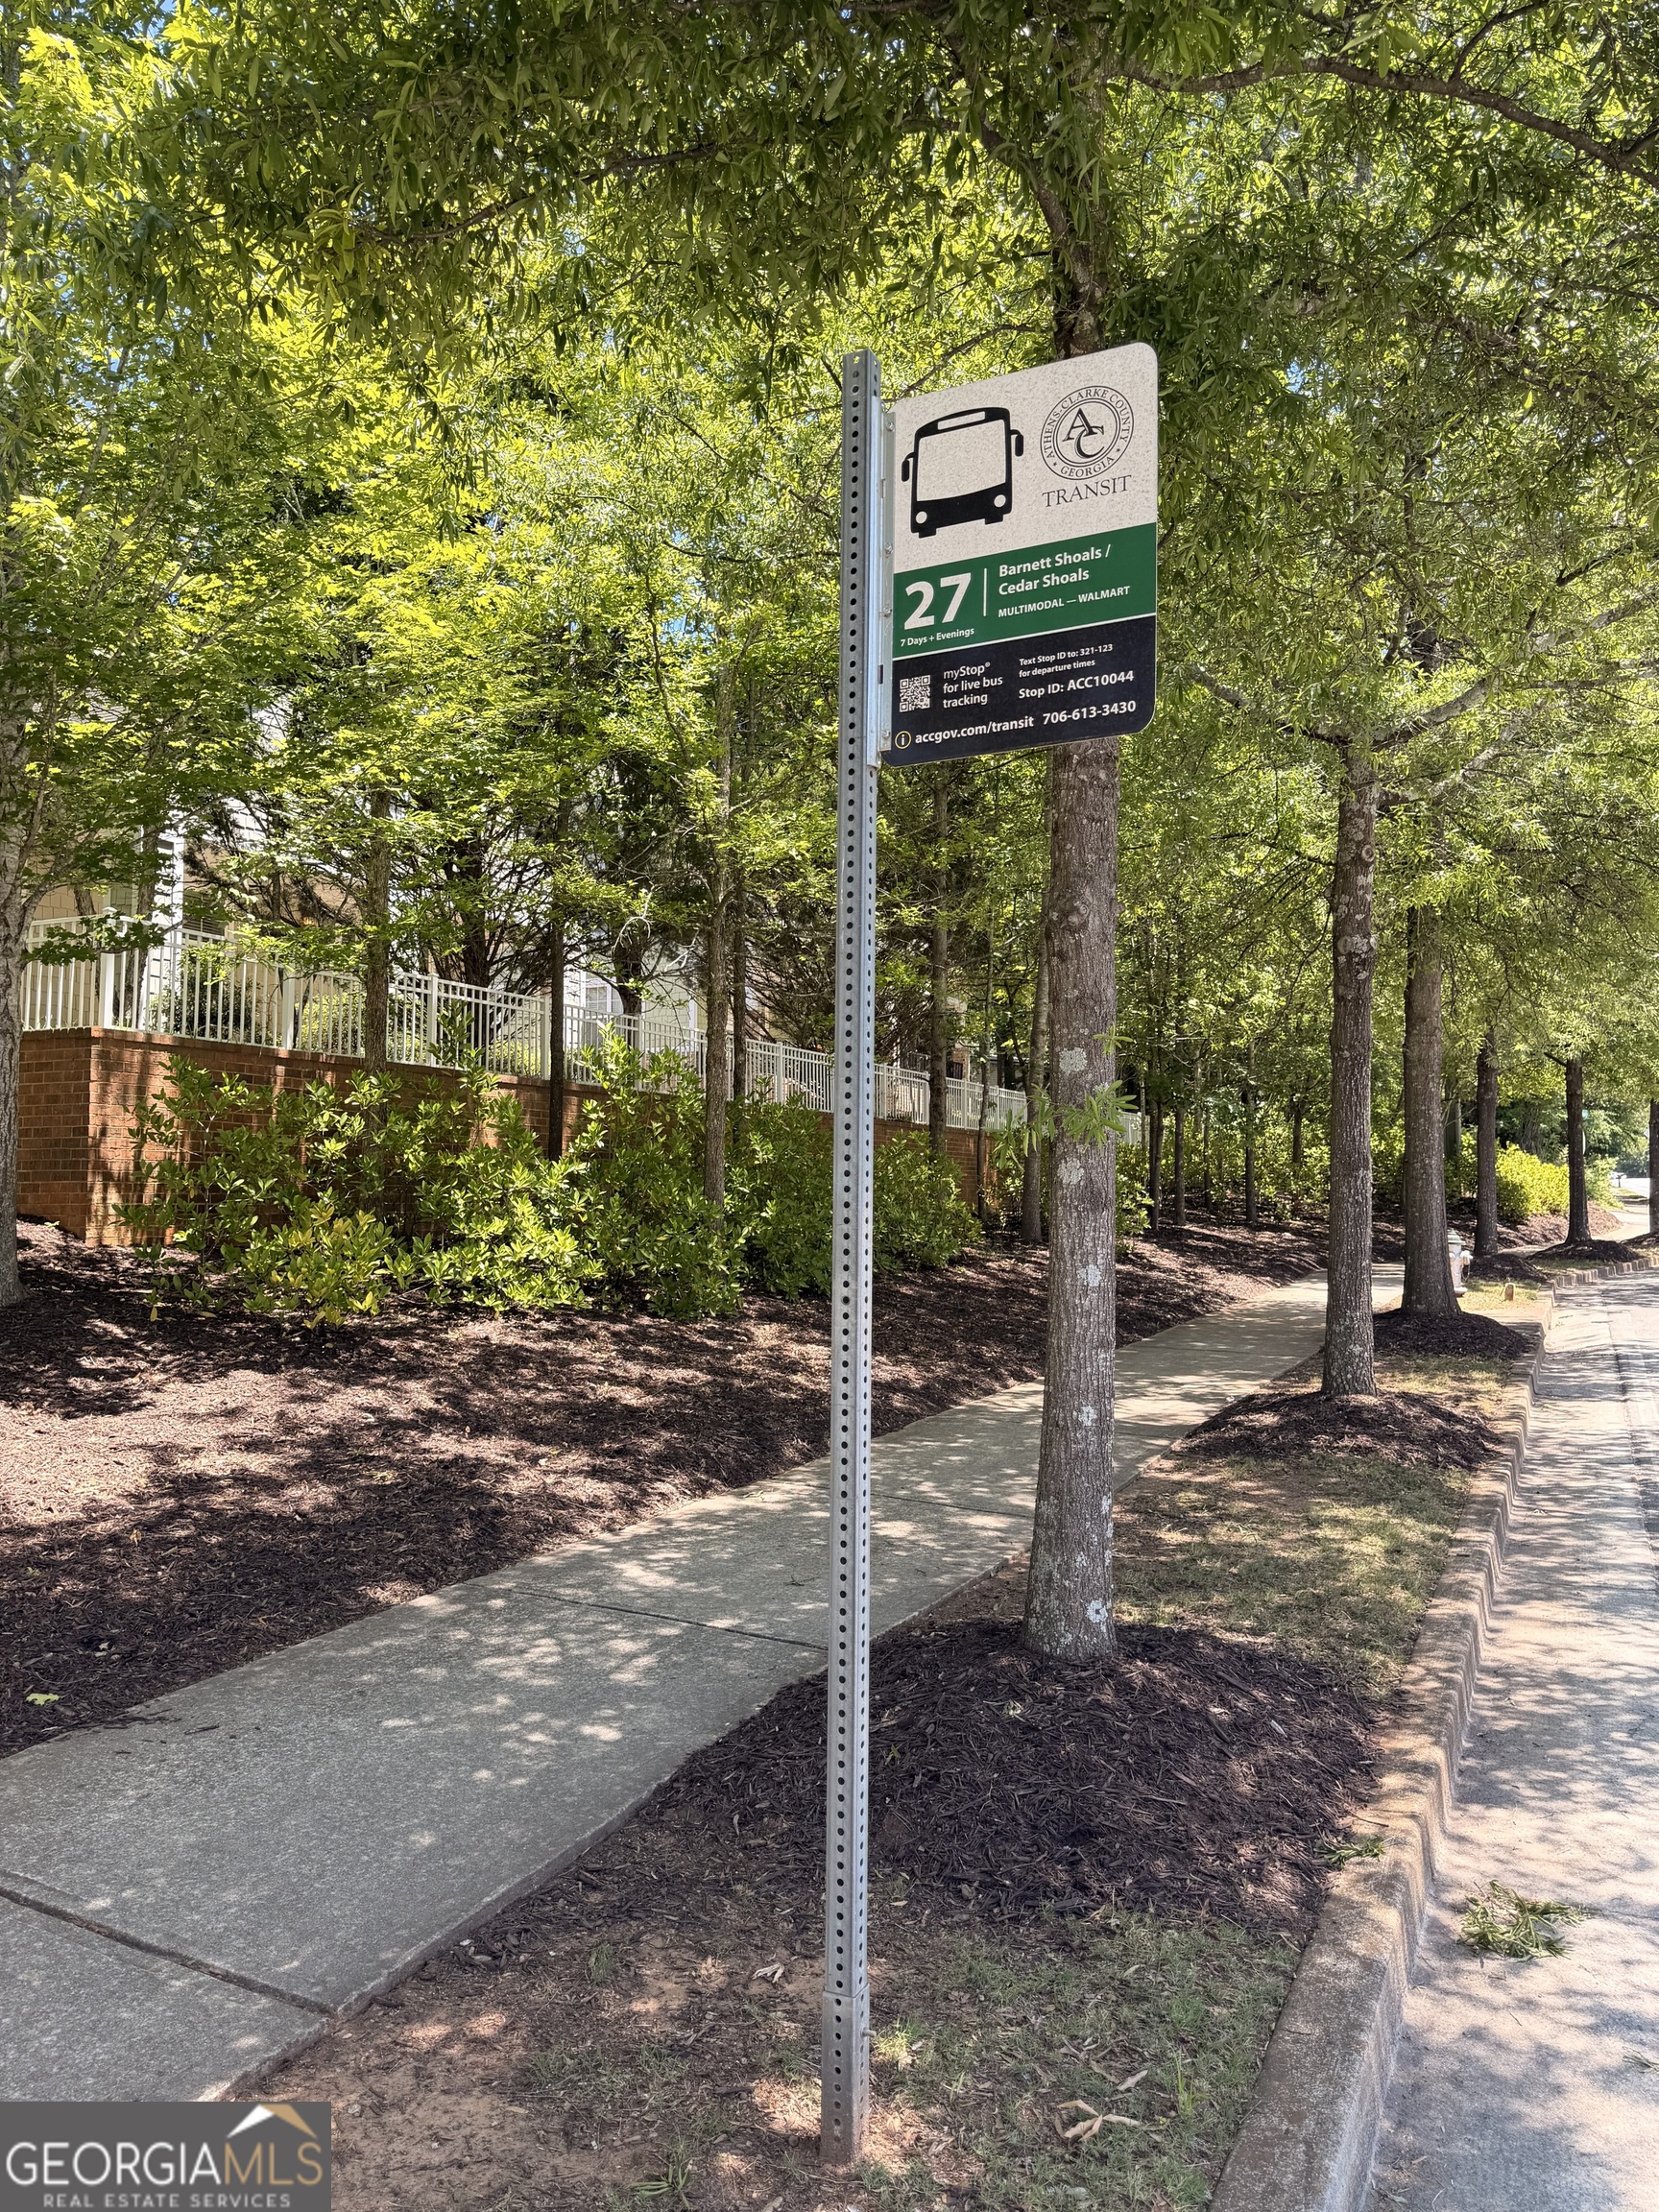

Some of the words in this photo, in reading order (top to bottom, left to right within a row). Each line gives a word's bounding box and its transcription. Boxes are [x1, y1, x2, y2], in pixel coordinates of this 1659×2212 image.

[1043, 388, 1109, 459] ATHENS-CLARKE
[1109, 393, 1131, 443] COUNTY
[1060, 455, 1115, 478] GEORGIA
[1042, 474, 1132, 508] TRANSIT
[998, 554, 1052, 578] Barnett
[1054, 546, 1103, 567] Shoals
[998, 577, 1040, 596] Cedar
[1042, 567, 1090, 589] Shoals
[903, 571, 972, 631] 27
[998, 597, 1065, 618] MULTIMODAL
[1077, 585, 1131, 604] WALMART
[900, 638, 906, 647] 7
[906, 635, 928, 646] Days
[936, 626, 975, 642] Evenings
[1019, 657, 1036, 667] Text
[1037, 654, 1056, 666] Stop
[1056, 652, 1067, 661] ID
[1067, 650, 1079, 660] to:
[1079, 643, 1114, 658] 321-123
[1019, 668, 1031, 679] for
[1031, 662, 1072, 678] departure
[1072, 659, 1096, 670] times
[943, 681, 960, 695] for
[960, 678, 981, 692] live
[982, 675, 1003, 688] bus
[1019, 686, 1046, 700] Stop
[1047, 683, 1065, 695] ID:
[1067, 669, 1135, 692] ACC10044
[942, 692, 989, 709] tracking
[914, 715, 1035, 745] accgov.com/transit
[1042, 699, 1137, 727] 706-613-3430
